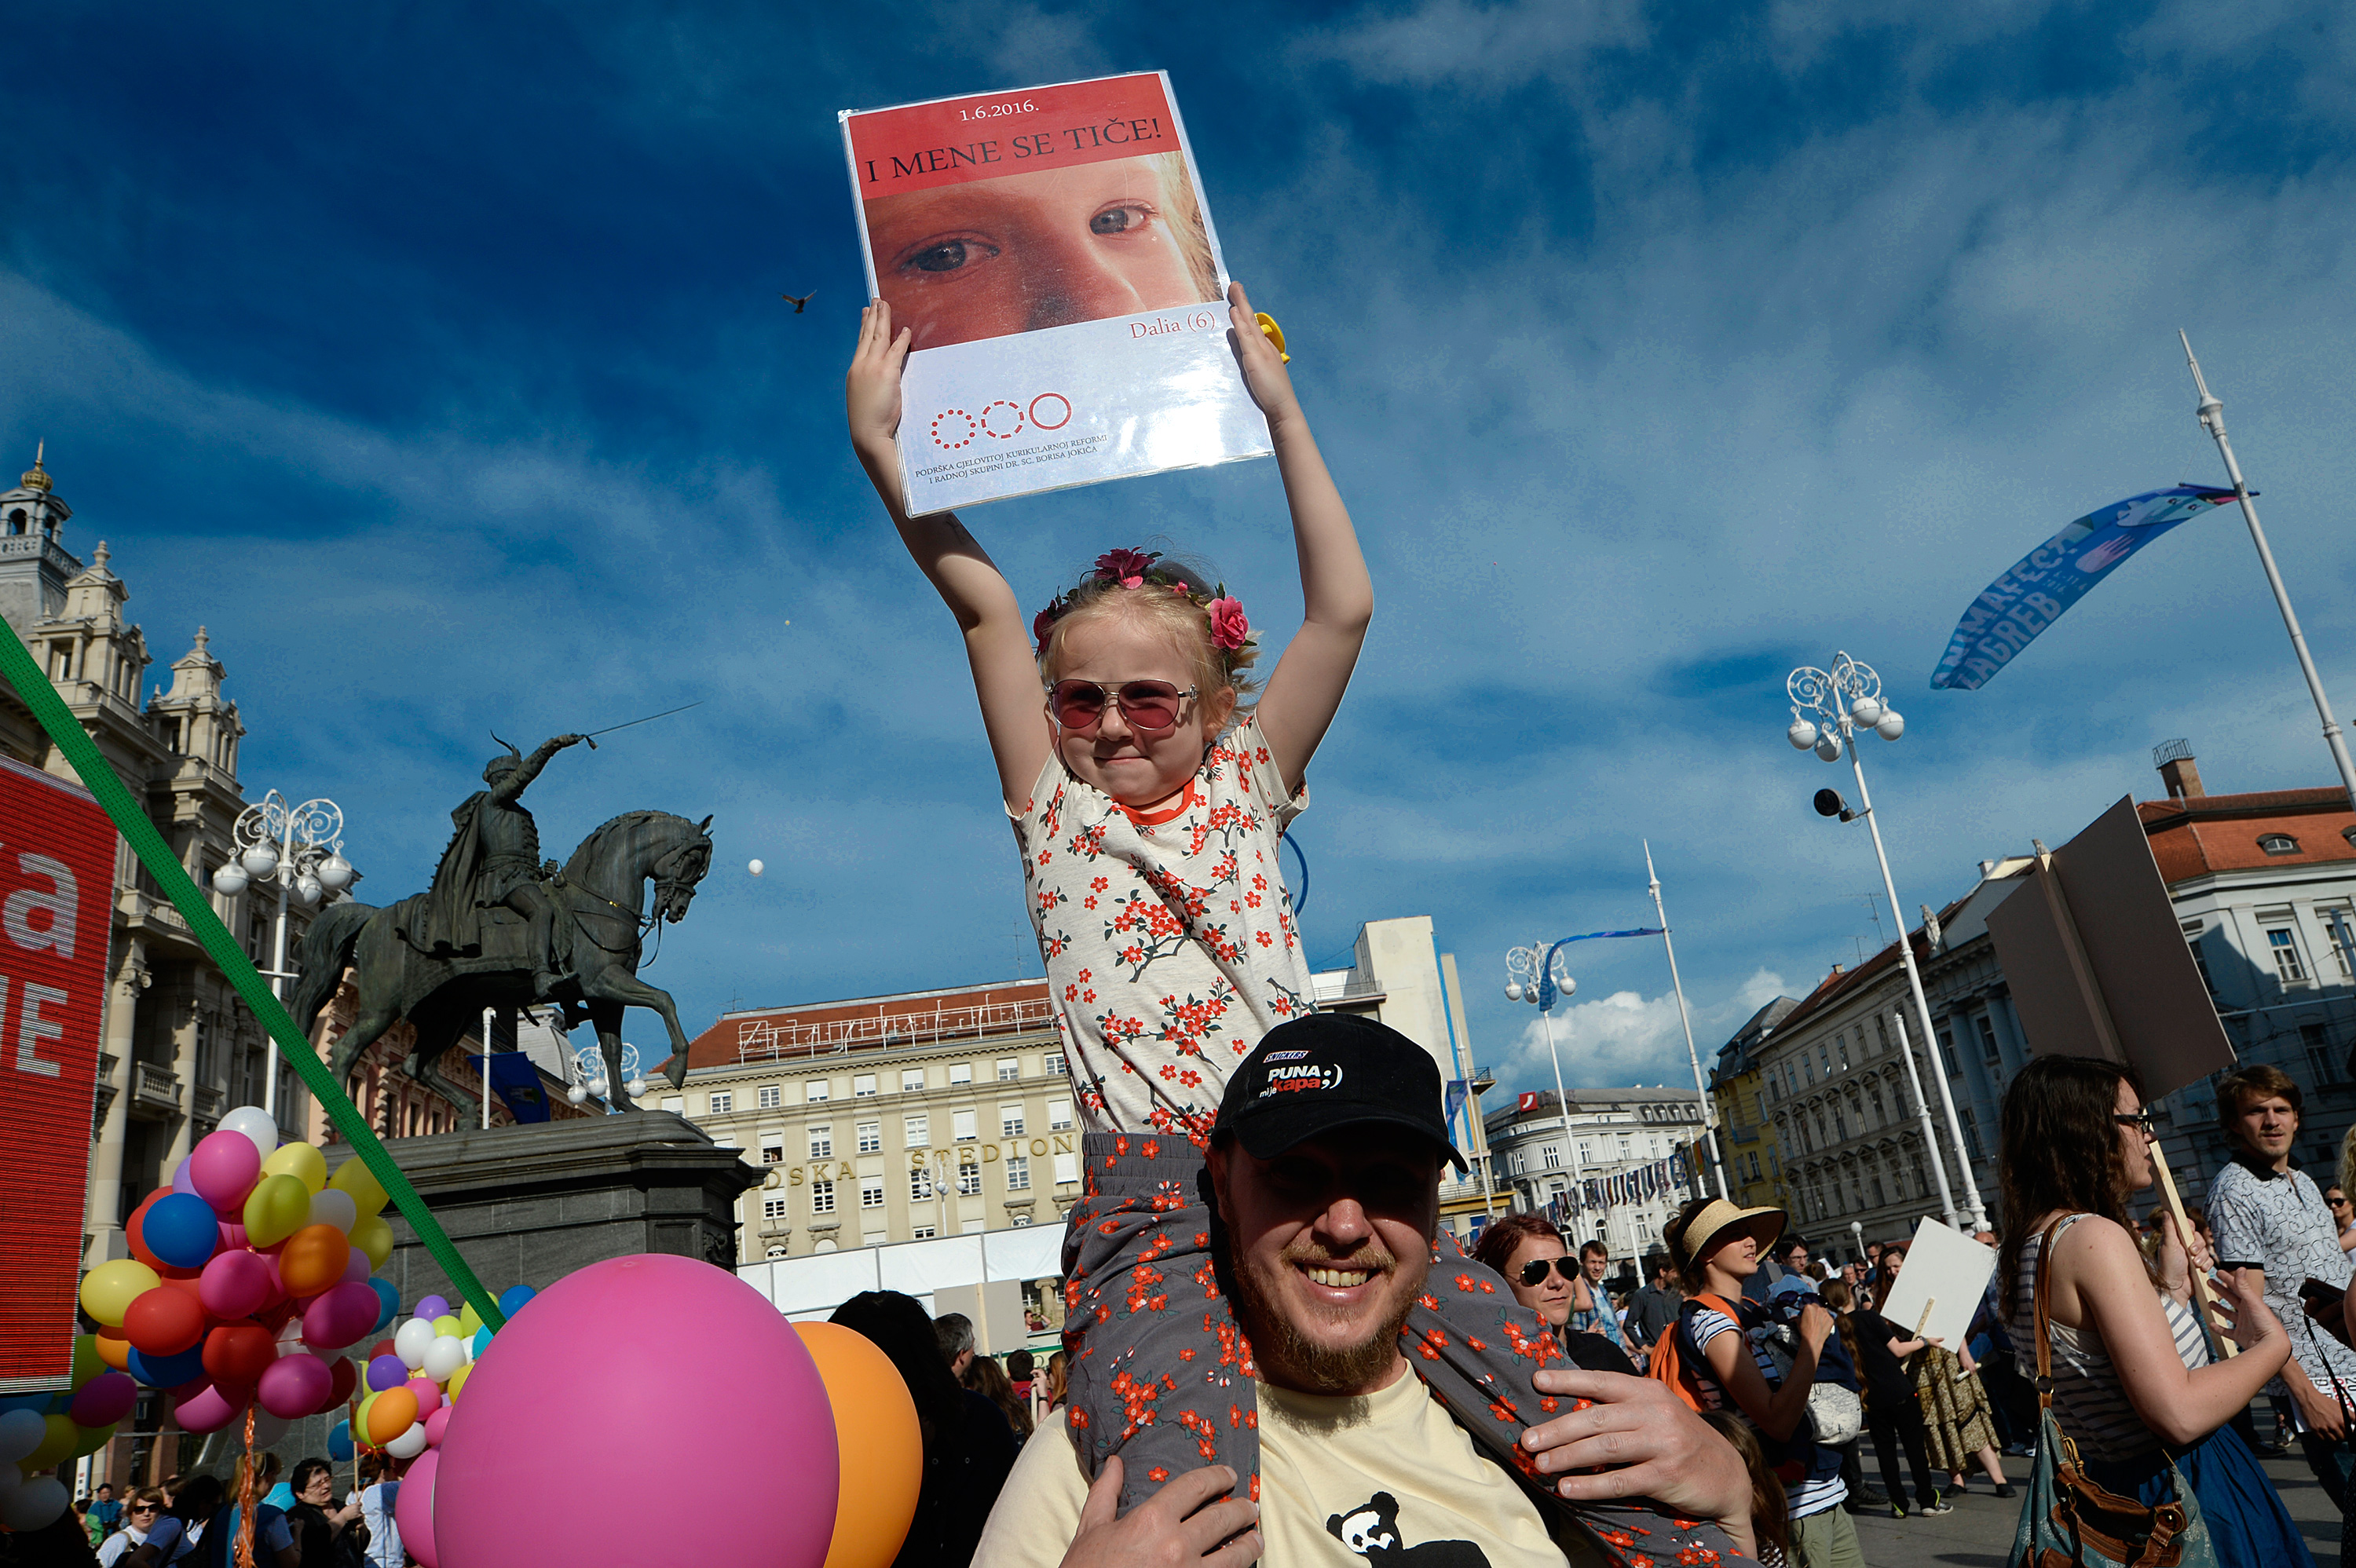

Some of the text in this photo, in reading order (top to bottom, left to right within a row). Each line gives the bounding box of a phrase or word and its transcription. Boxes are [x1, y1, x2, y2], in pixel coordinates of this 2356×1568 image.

[960, 99, 1040, 122] 1.6.2016.
[865, 118, 1162, 183] I MENE SE TIČE!
[1129, 311, 1216, 339] Dalia (6)
[915, 434, 1107, 477] PODRŠKA CJELOVITOJ KURIKULARNOJ REFORMI
[935, 471, 968, 484] RADNOJ
[970, 464, 1004, 476] SKUPINI
[1006, 460, 1019, 469] DR.
[1021, 457, 1034, 466] SC.
[1036, 452, 1066, 463] BORISA
[0, 842, 79, 959] a
[1265, 1051, 1307, 1062] SNICKERS
[1268, 1065, 1321, 1083] PUNA
[1272, 1078, 1321, 1093] kapa
[752, 1161, 856, 1190] DSKA
